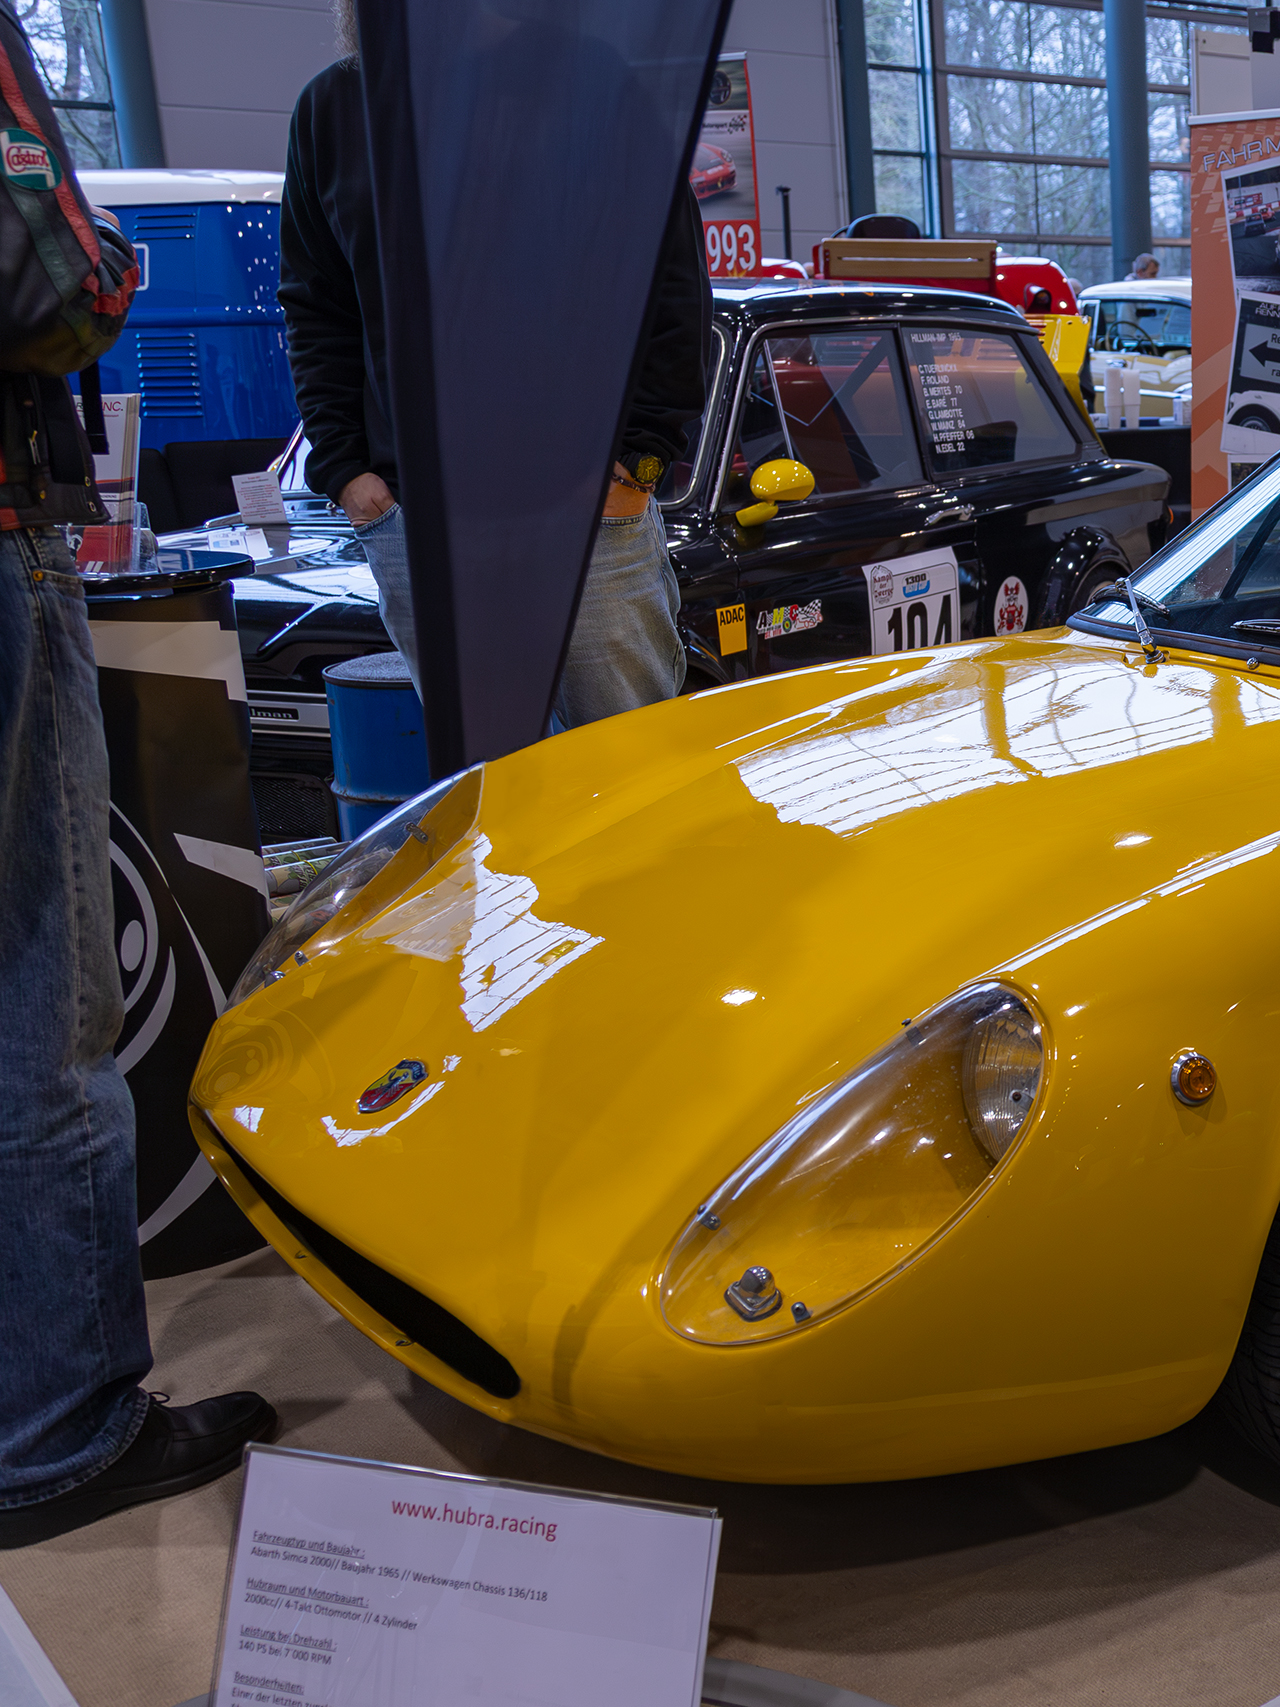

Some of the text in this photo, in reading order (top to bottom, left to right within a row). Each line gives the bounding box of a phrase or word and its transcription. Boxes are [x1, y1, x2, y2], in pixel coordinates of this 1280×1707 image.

[6, 145, 50, 173] Castrol
[1203, 140, 1263, 171] FAHR
[905, 572, 927, 586] 1300
[719, 607, 744, 626] ADAC
[887, 594, 953, 653] 104
[250, 708, 293, 719] lman
[392, 1500, 558, 1542] www.hubra.racing
[252, 1530, 306, 1549] Fahrzeugtyp
[307, 1541, 325, 1552] und
[326, 1542, 360, 1557] Baujahr
[251, 1546, 280, 1559] Abarth
[281, 1551, 308, 1564] Simca
[341, 1561, 375, 1575] Baujahr
[377, 1566, 400, 1578] 1965
[412, 1571, 471, 1590] Werkswagen
[472, 1581, 505, 1596] Chassis
[508, 1587, 548, 1602] 136/118
[246, 1577, 287, 1594] Hubraum
[288, 1584, 305, 1596] und
[307, 1586, 364, 1606] Motorbauart
[284, 1600, 312, 1613] 4-Takt
[314, 1604, 361, 1621] Ottomotor
[374, 1614, 380, 1623] 4
[381, 1615, 418, 1631] Zylinder
[240, 1624, 276, 1641] Leistung
[293, 1633, 333, 1649] Drehzahl
[239, 1640, 255, 1652] 140
[256, 1643, 268, 1654] PS
[310, 1653, 332, 1665] RPM
[231, 1686, 254, 1699] Einer
[255, 1691, 271, 1703] der
